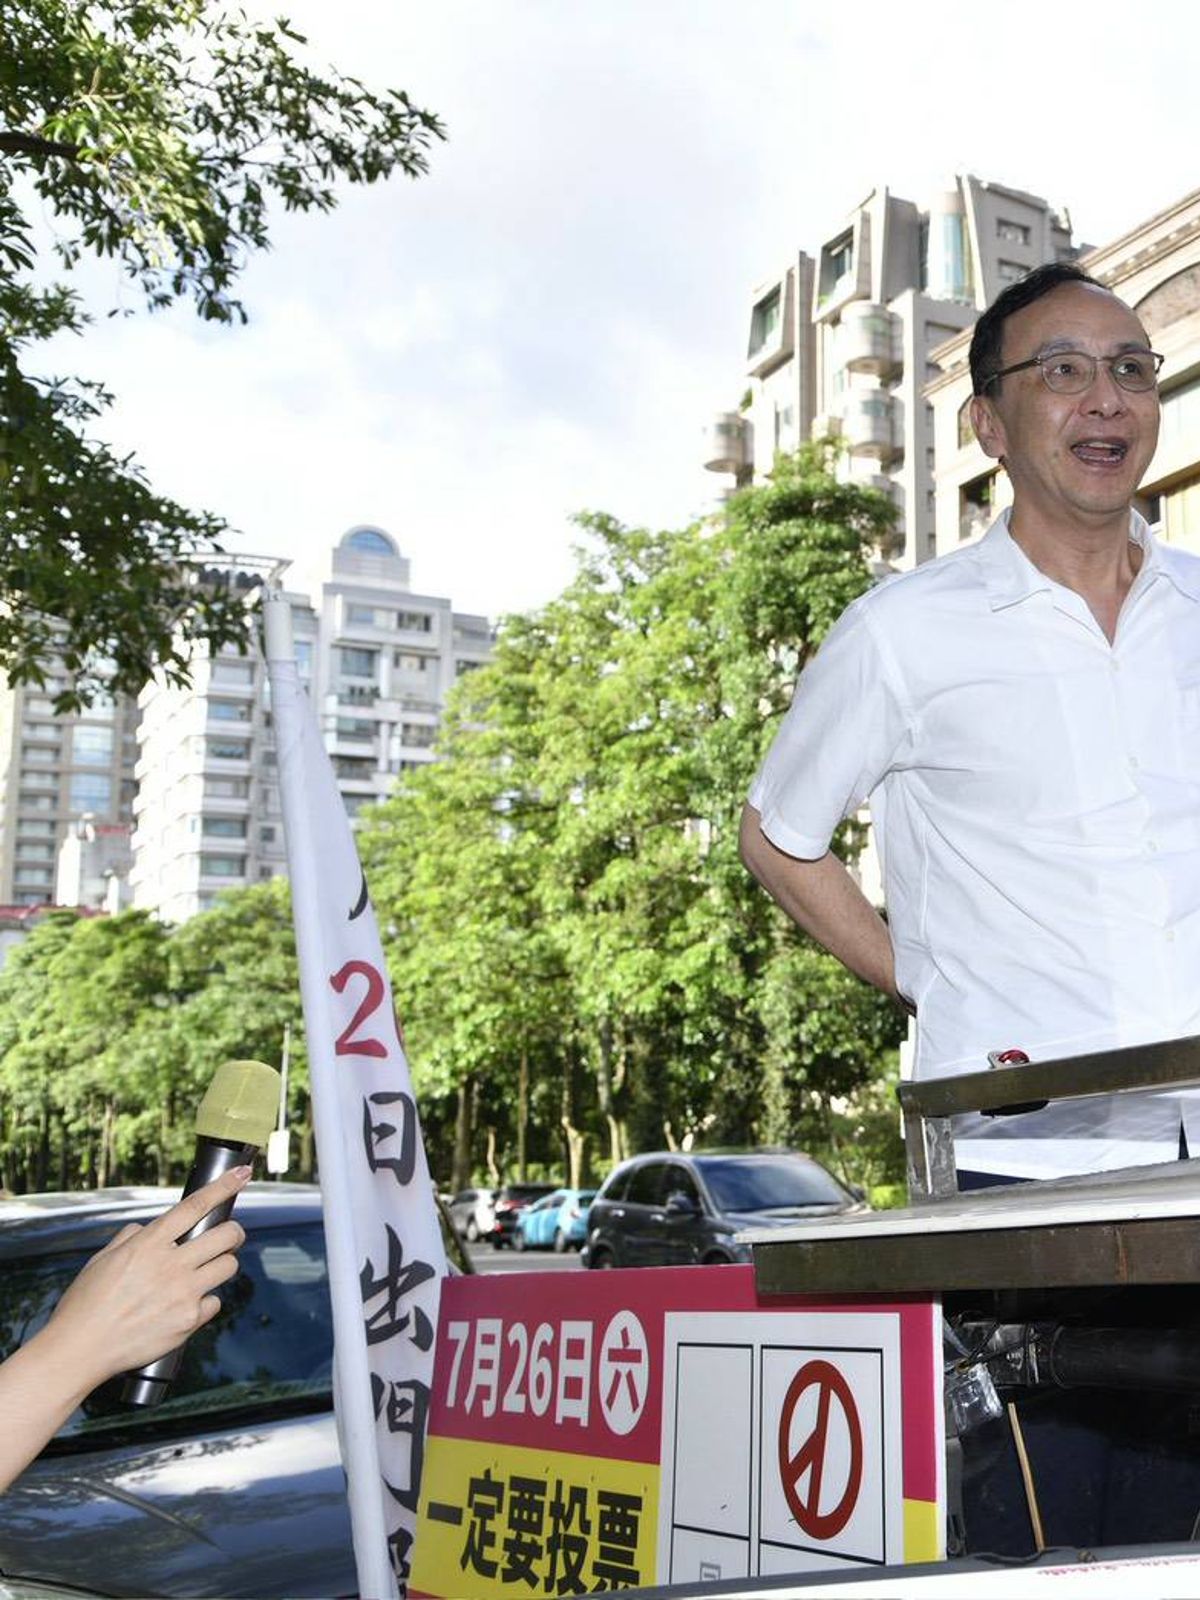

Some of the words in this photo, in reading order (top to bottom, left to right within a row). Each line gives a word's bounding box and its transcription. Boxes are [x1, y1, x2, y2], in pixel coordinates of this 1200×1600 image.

[426, 1467, 643, 1597] 一定要投票
